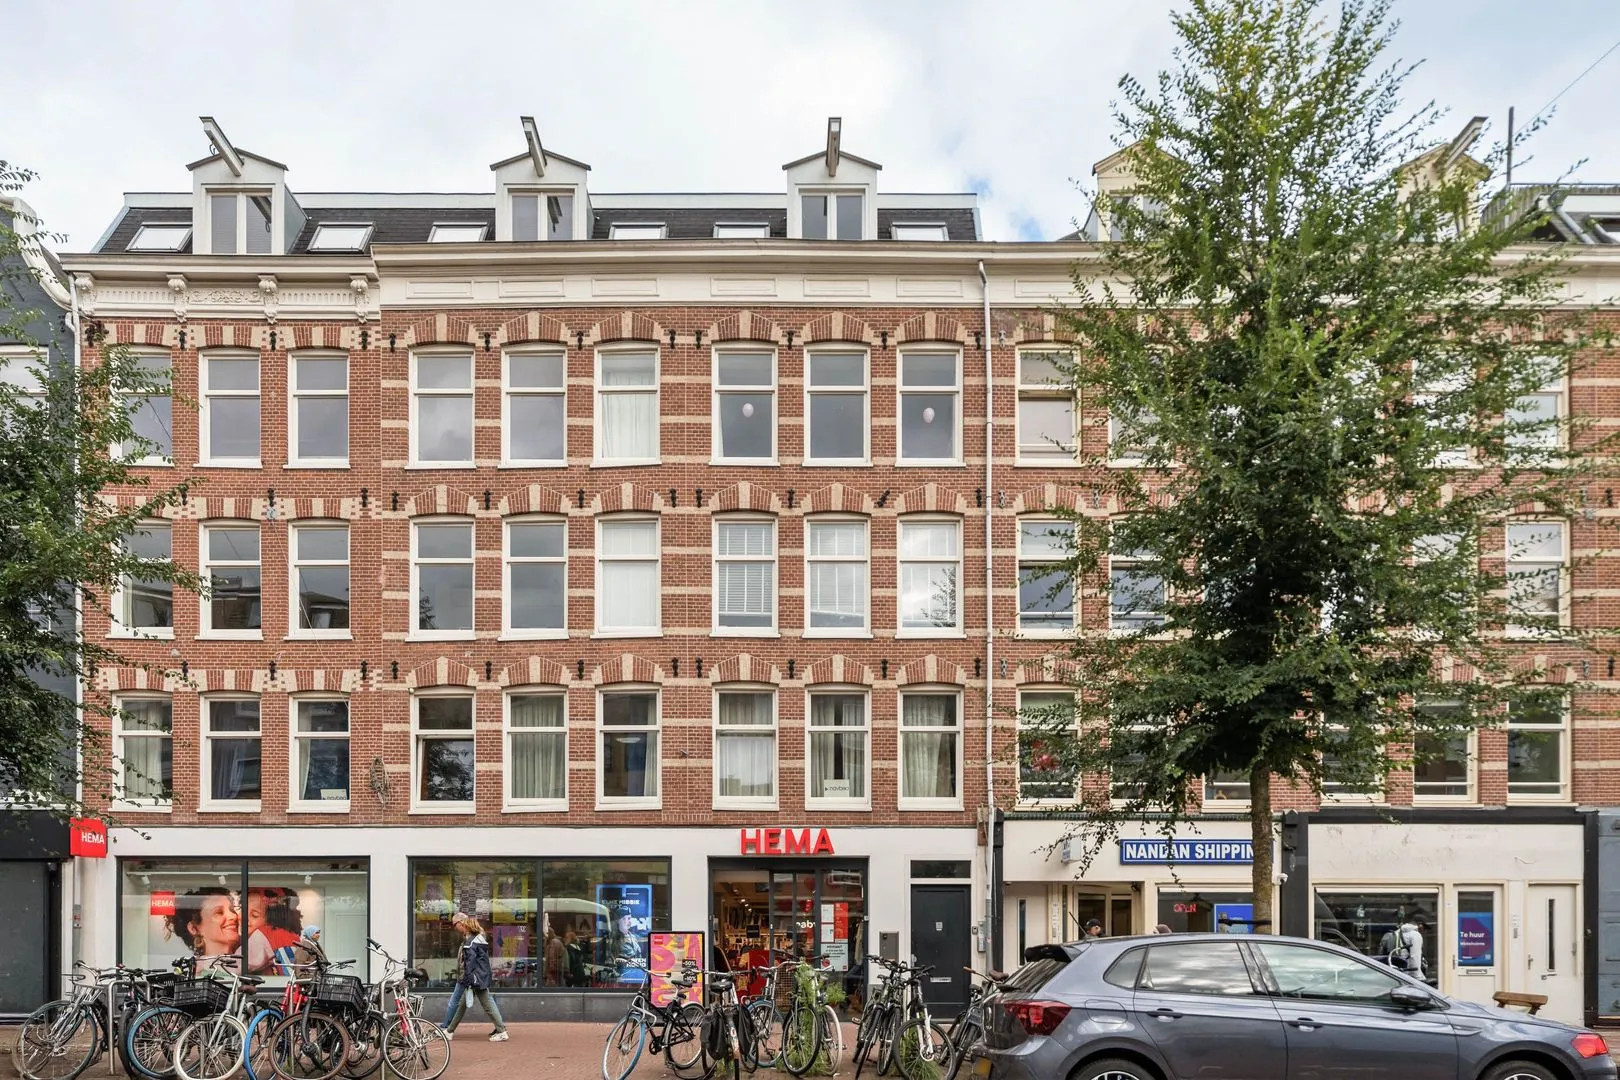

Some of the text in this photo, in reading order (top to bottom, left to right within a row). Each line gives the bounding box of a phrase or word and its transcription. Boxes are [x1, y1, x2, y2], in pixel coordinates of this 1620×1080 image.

[81, 832, 105, 844] HEMA
[741, 828, 835, 855] HEMA
[1125, 843, 1254, 859] NANDAN SHIPPIN
